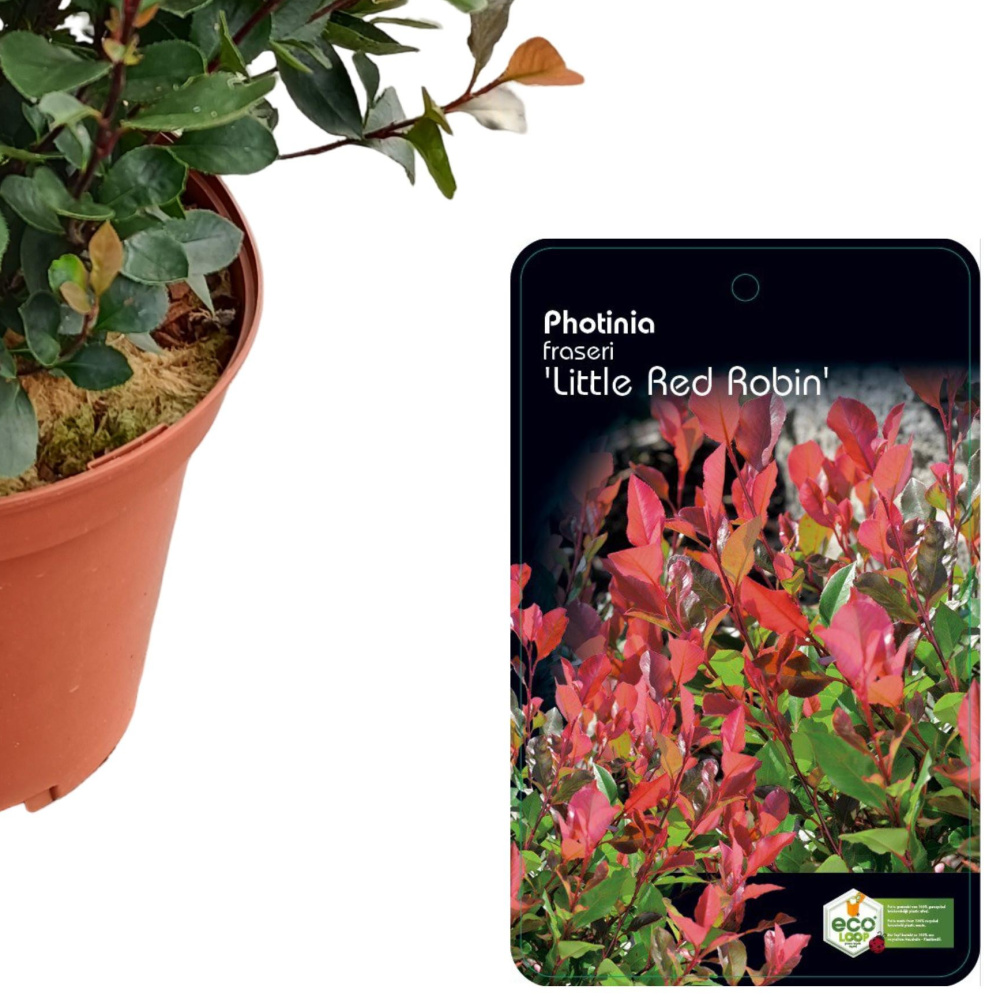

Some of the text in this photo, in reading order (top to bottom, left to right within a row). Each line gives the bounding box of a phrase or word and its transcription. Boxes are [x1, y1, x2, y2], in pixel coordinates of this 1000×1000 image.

[544, 309, 655, 334] Photinia
[543, 340, 614, 360] fraseri
[545, 365, 828, 397] 'Little Red Robin'
[831, 917, 876, 932] eco
[838, 932, 870, 942] LOOP
